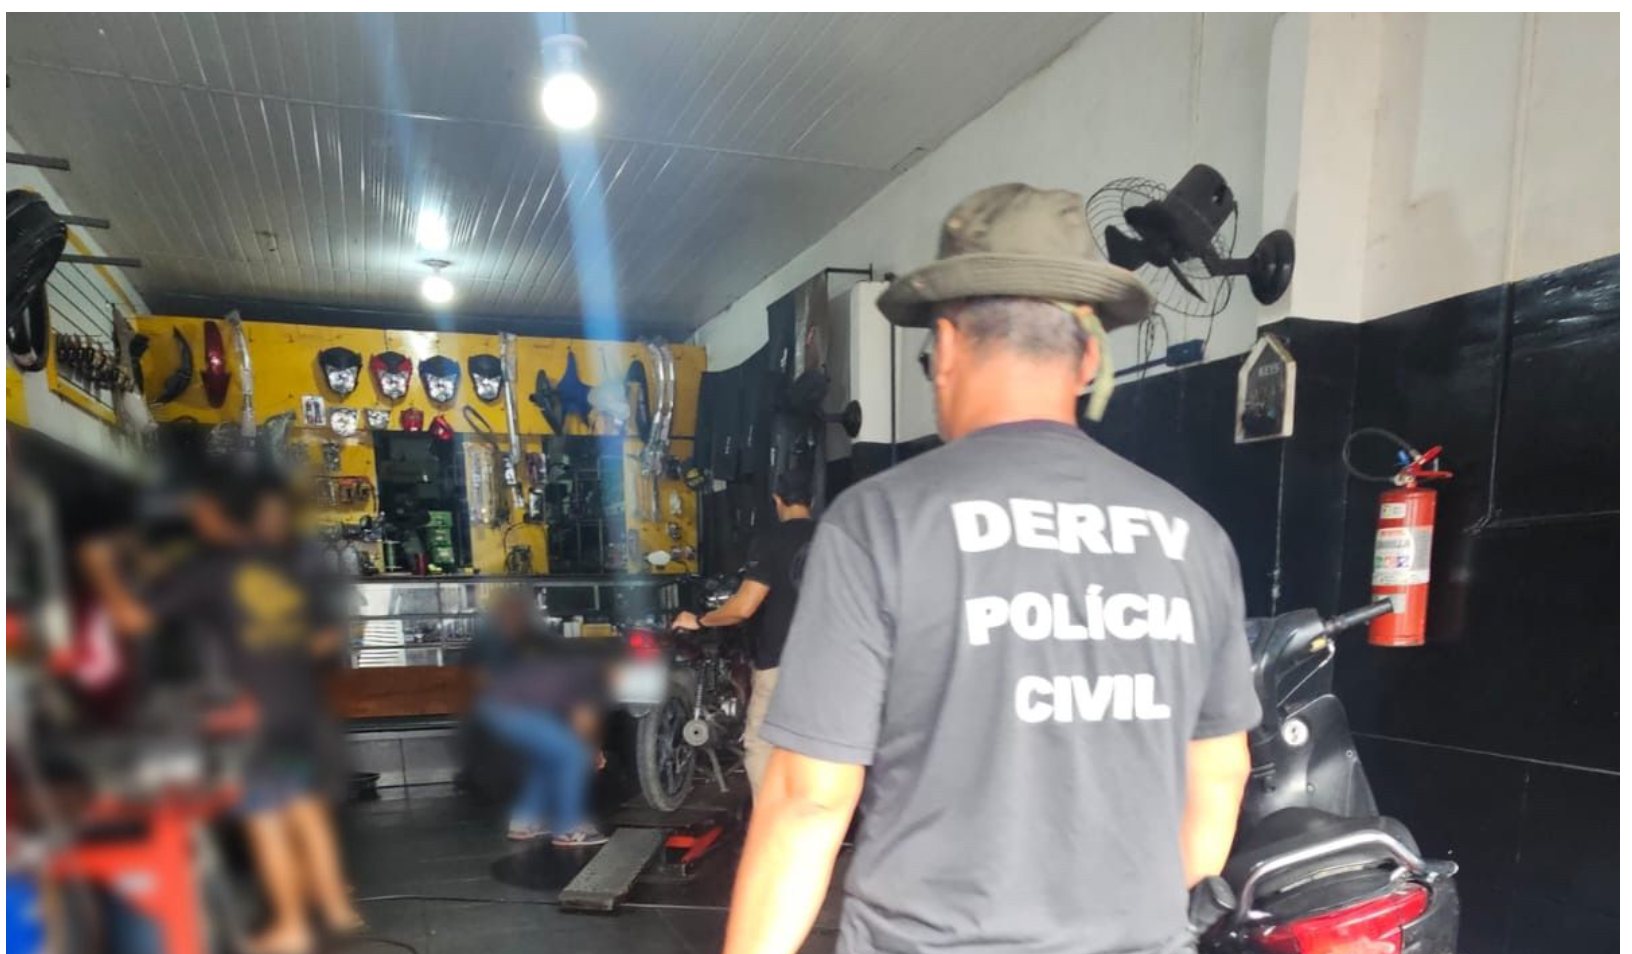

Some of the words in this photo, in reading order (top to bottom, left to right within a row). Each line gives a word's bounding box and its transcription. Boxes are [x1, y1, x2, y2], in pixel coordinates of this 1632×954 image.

[951, 498, 1190, 560] DERFV
[965, 583, 1195, 645] POLÍCIA
[1015, 673, 1171, 723] CIVIL
